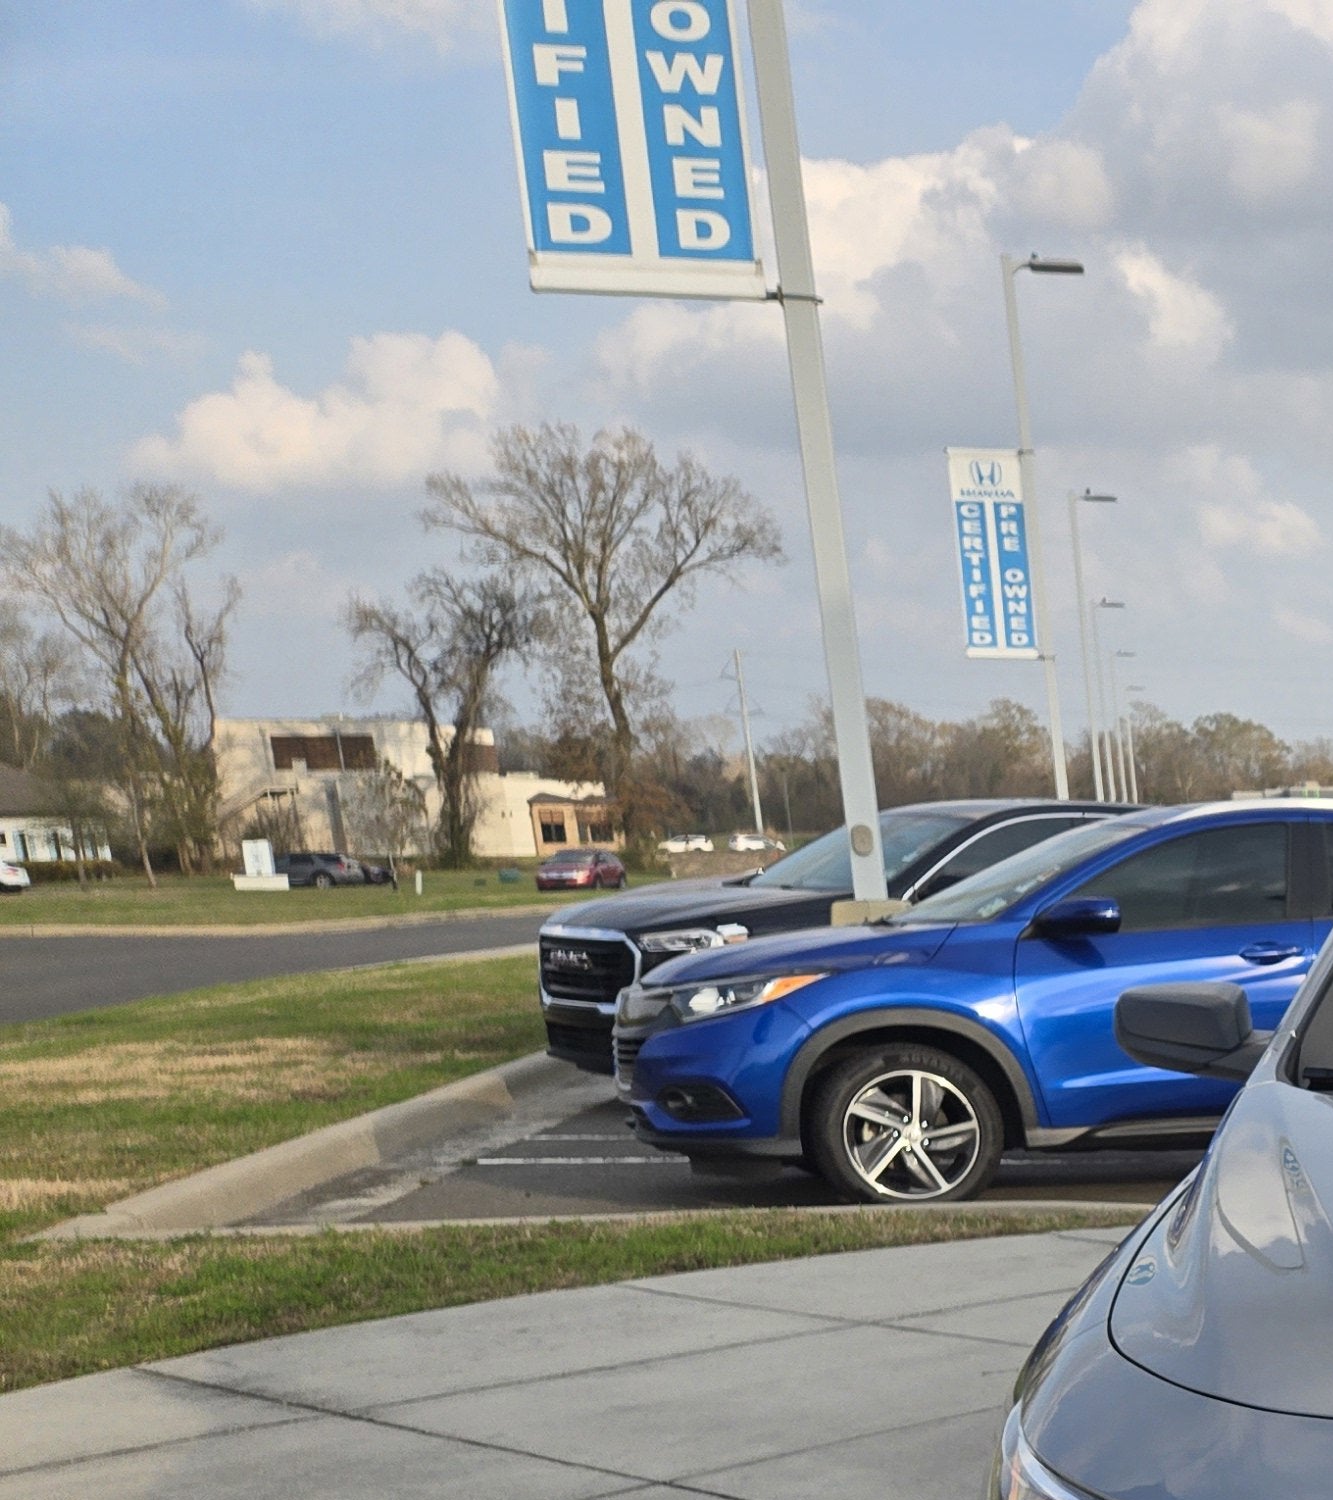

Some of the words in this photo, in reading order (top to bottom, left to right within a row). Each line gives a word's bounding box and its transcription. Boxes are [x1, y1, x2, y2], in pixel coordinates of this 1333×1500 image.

[645, 0, 731, 250] OWNED
[960, 503, 993, 645] CERTIFIED
[1000, 504, 1021, 552] PRE
[1003, 567, 1029, 646] OWNED
